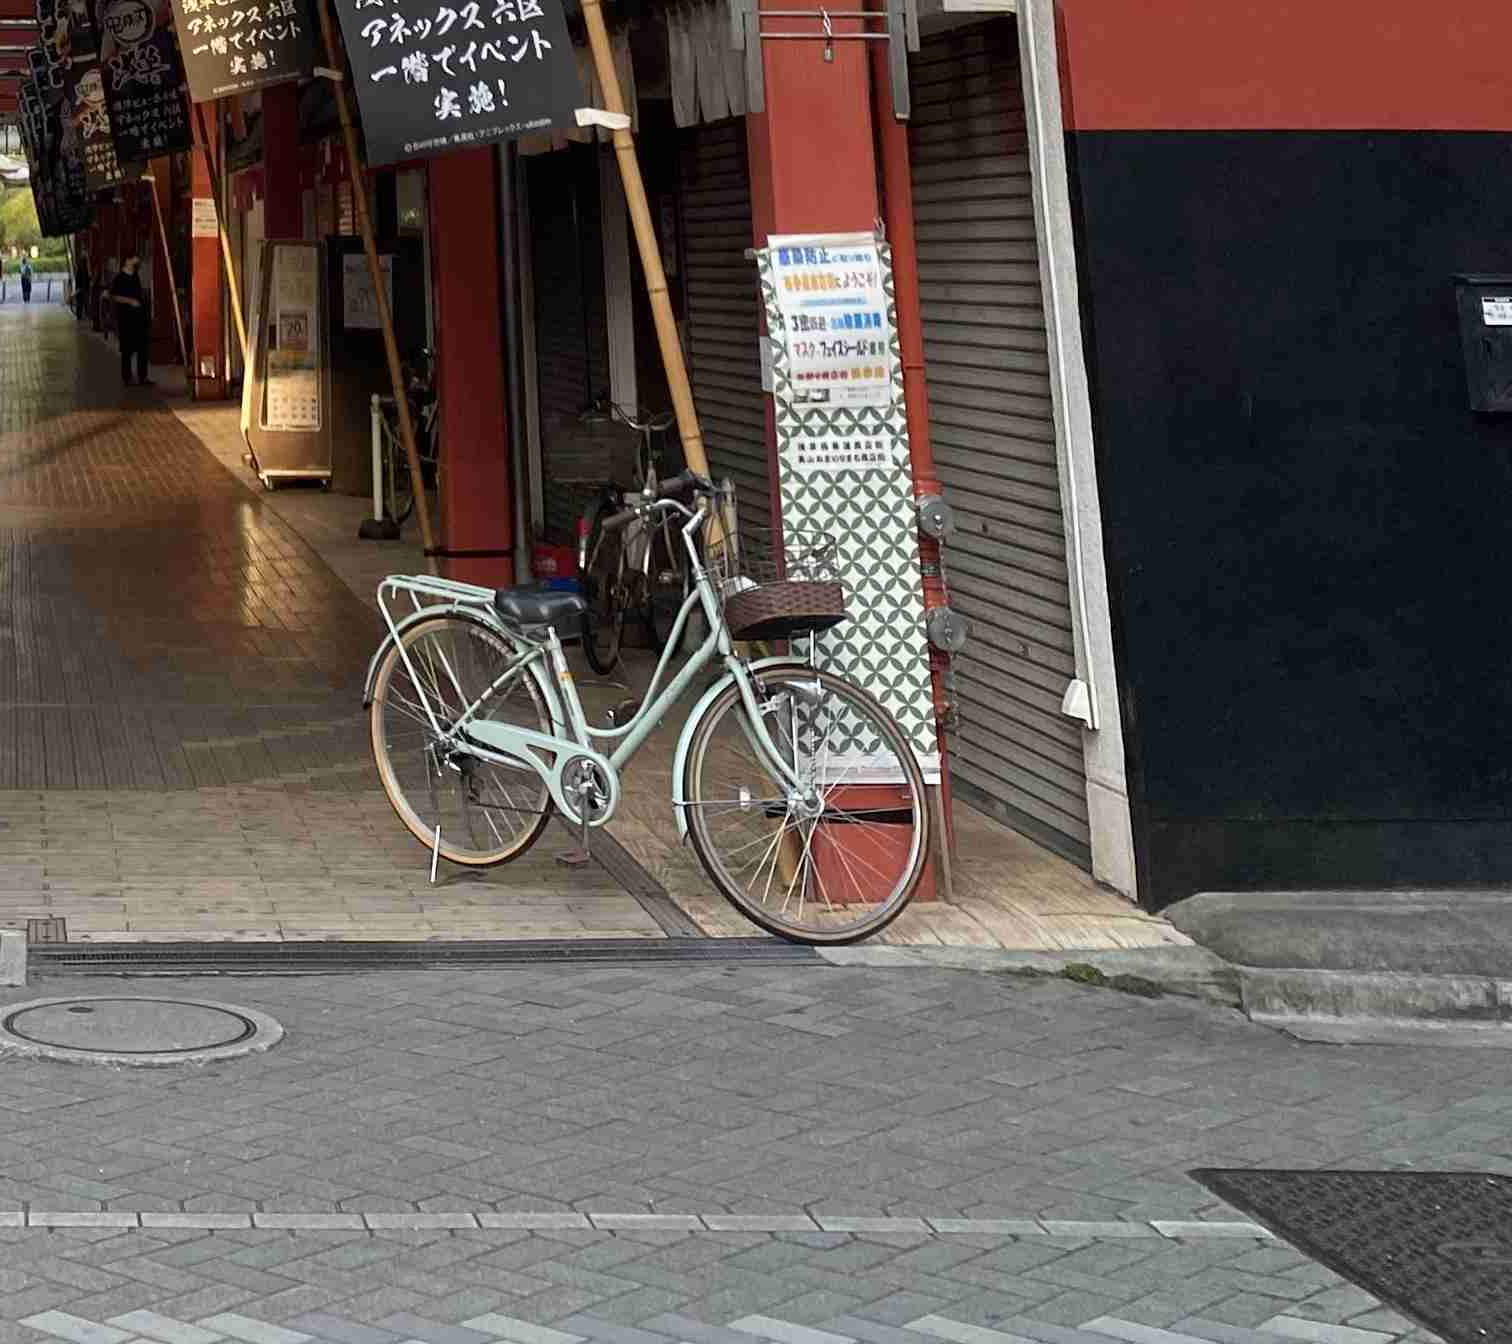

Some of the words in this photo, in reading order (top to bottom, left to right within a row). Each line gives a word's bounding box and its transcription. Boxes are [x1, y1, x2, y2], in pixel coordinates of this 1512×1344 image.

[187, 4, 263, 37] アネックス
[192, 21, 303, 56] 一階でイベント
[361, 2, 485, 47] アネックス
[371, 29, 552, 84] 一階でイベント
